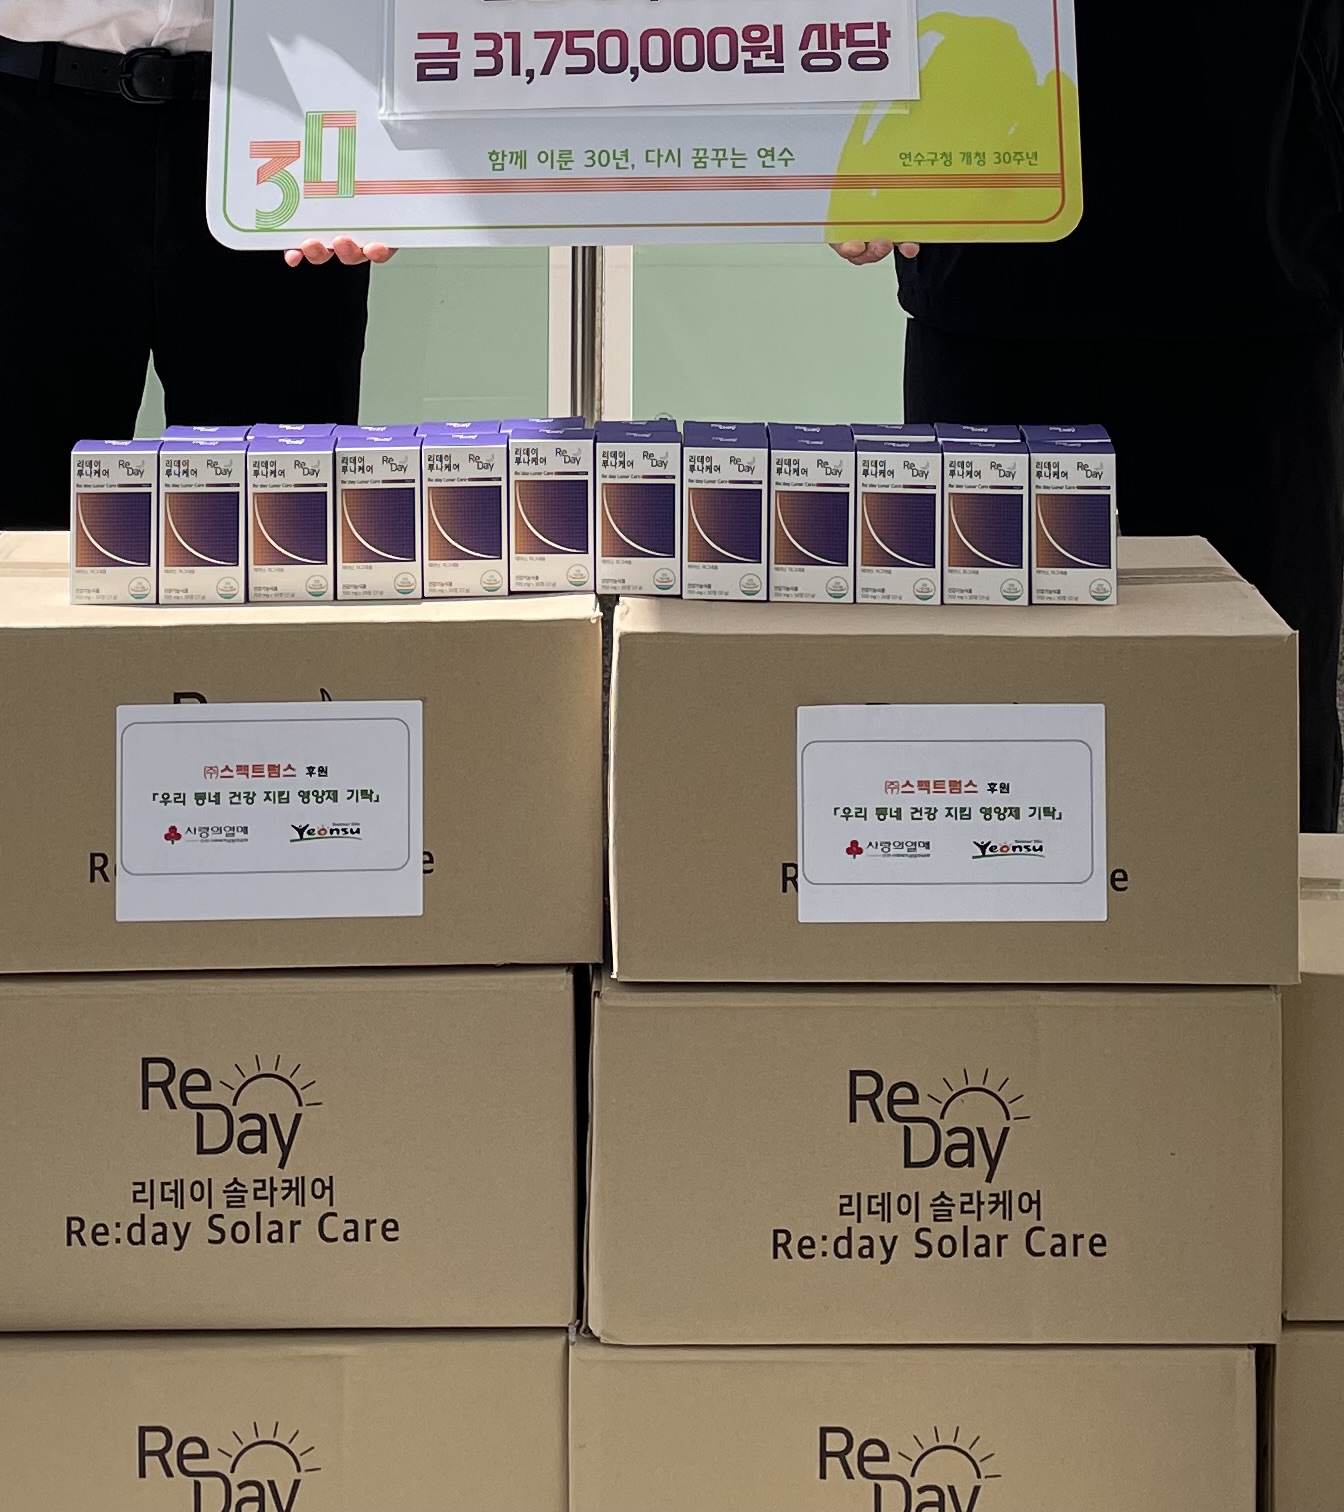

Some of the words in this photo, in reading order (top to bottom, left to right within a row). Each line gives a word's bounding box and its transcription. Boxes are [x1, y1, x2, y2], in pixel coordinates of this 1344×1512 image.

[415, 32, 460, 82] 금
[474, 24, 784, 84] 31,750,000원
[799, 22, 891, 72] 상당
[488, 150, 526, 171] 함께
[538, 150, 574, 170] 이룬
[584, 149, 635, 170] 30년,
[646, 148, 681, 168] 다시
[691, 148, 748, 169] 꿈꾸는
[757, 147, 795, 168] 연수
[898, 149, 954, 168] 연수구청
[959, 150, 988, 167] 개청
[992, 150, 1040, 167] 30주년
[515, 448, 538, 456] 리데이
[556, 448, 567, 456] Re
[602, 450, 626, 459] 리데이
[643, 451, 654, 460] Re
[341, 456, 365, 465] 리데이
[382, 456, 394, 465] Re
[428, 454, 451, 462] 리데이
[468, 454, 480, 462] Re
[564, 455, 581, 465] Day
[651, 458, 668, 469] Day
[689, 456, 712, 464] 리데이
[730, 456, 741, 465] Re
[776, 458, 800, 466] 리데이
[77, 460, 101, 468] 리데이
[118, 460, 130, 468] Re
[165, 460, 189, 468] 리데이
[207, 460, 218, 468] Re
[253, 460, 276, 469] 리데이
[294, 460, 306, 469] Re
[390, 463, 408, 473] Day
[476, 461, 494, 472] Day
[738, 463, 755, 474] Day
[817, 460, 828, 468] Re
[862, 460, 886, 469] 리데이
[903, 461, 915, 469] Re
[949, 460, 973, 469] 리데이
[990, 462, 1002, 470] Re
[1036, 461, 1060, 470] 리데이
[1077, 462, 1089, 470] Re
[127, 467, 144, 478] Day
[215, 467, 233, 478] Day
[303, 467, 320, 478] Day
[825, 466, 843, 477] Day
[911, 468, 929, 479] Day
[998, 469, 1016, 479] Day
[1085, 469, 1104, 480] Day
[306, 765, 328, 777] 후원
[987, 782, 1010, 794] 후원
[229, 791, 256, 805] 건강
[298, 790, 338, 804] 영양제
[910, 807, 938, 820] 건강
[980, 807, 1020, 821] 영양제
[185, 826, 248, 839] 사랑의열매
[291, 823, 361, 839] Yeonsu
[866, 841, 930, 853] 사랑의열매
[973, 841, 1043, 856] Yeonsu
[140, 1056, 212, 1110] Re
[848, 1069, 920, 1123] Re
[195, 1103, 302, 1169] Day
[902, 1116, 1010, 1183] Day
[133, 1178, 212, 1210] 리데이
[223, 1176, 333, 1208] 솔라케어
[839, 1191, 919, 1223] 리데이
[930, 1190, 1041, 1222] 솔라케어
[67, 1213, 191, 1251] Re:day
[208, 1211, 301, 1244] Solar
[318, 1212, 399, 1243] Care
[773, 1226, 898, 1265] Re:day
[915, 1225, 1008, 1258] Solar
[1026, 1226, 1107, 1257] Care
[138, 1426, 209, 1479] Re
[819, 1426, 890, 1480] Re
